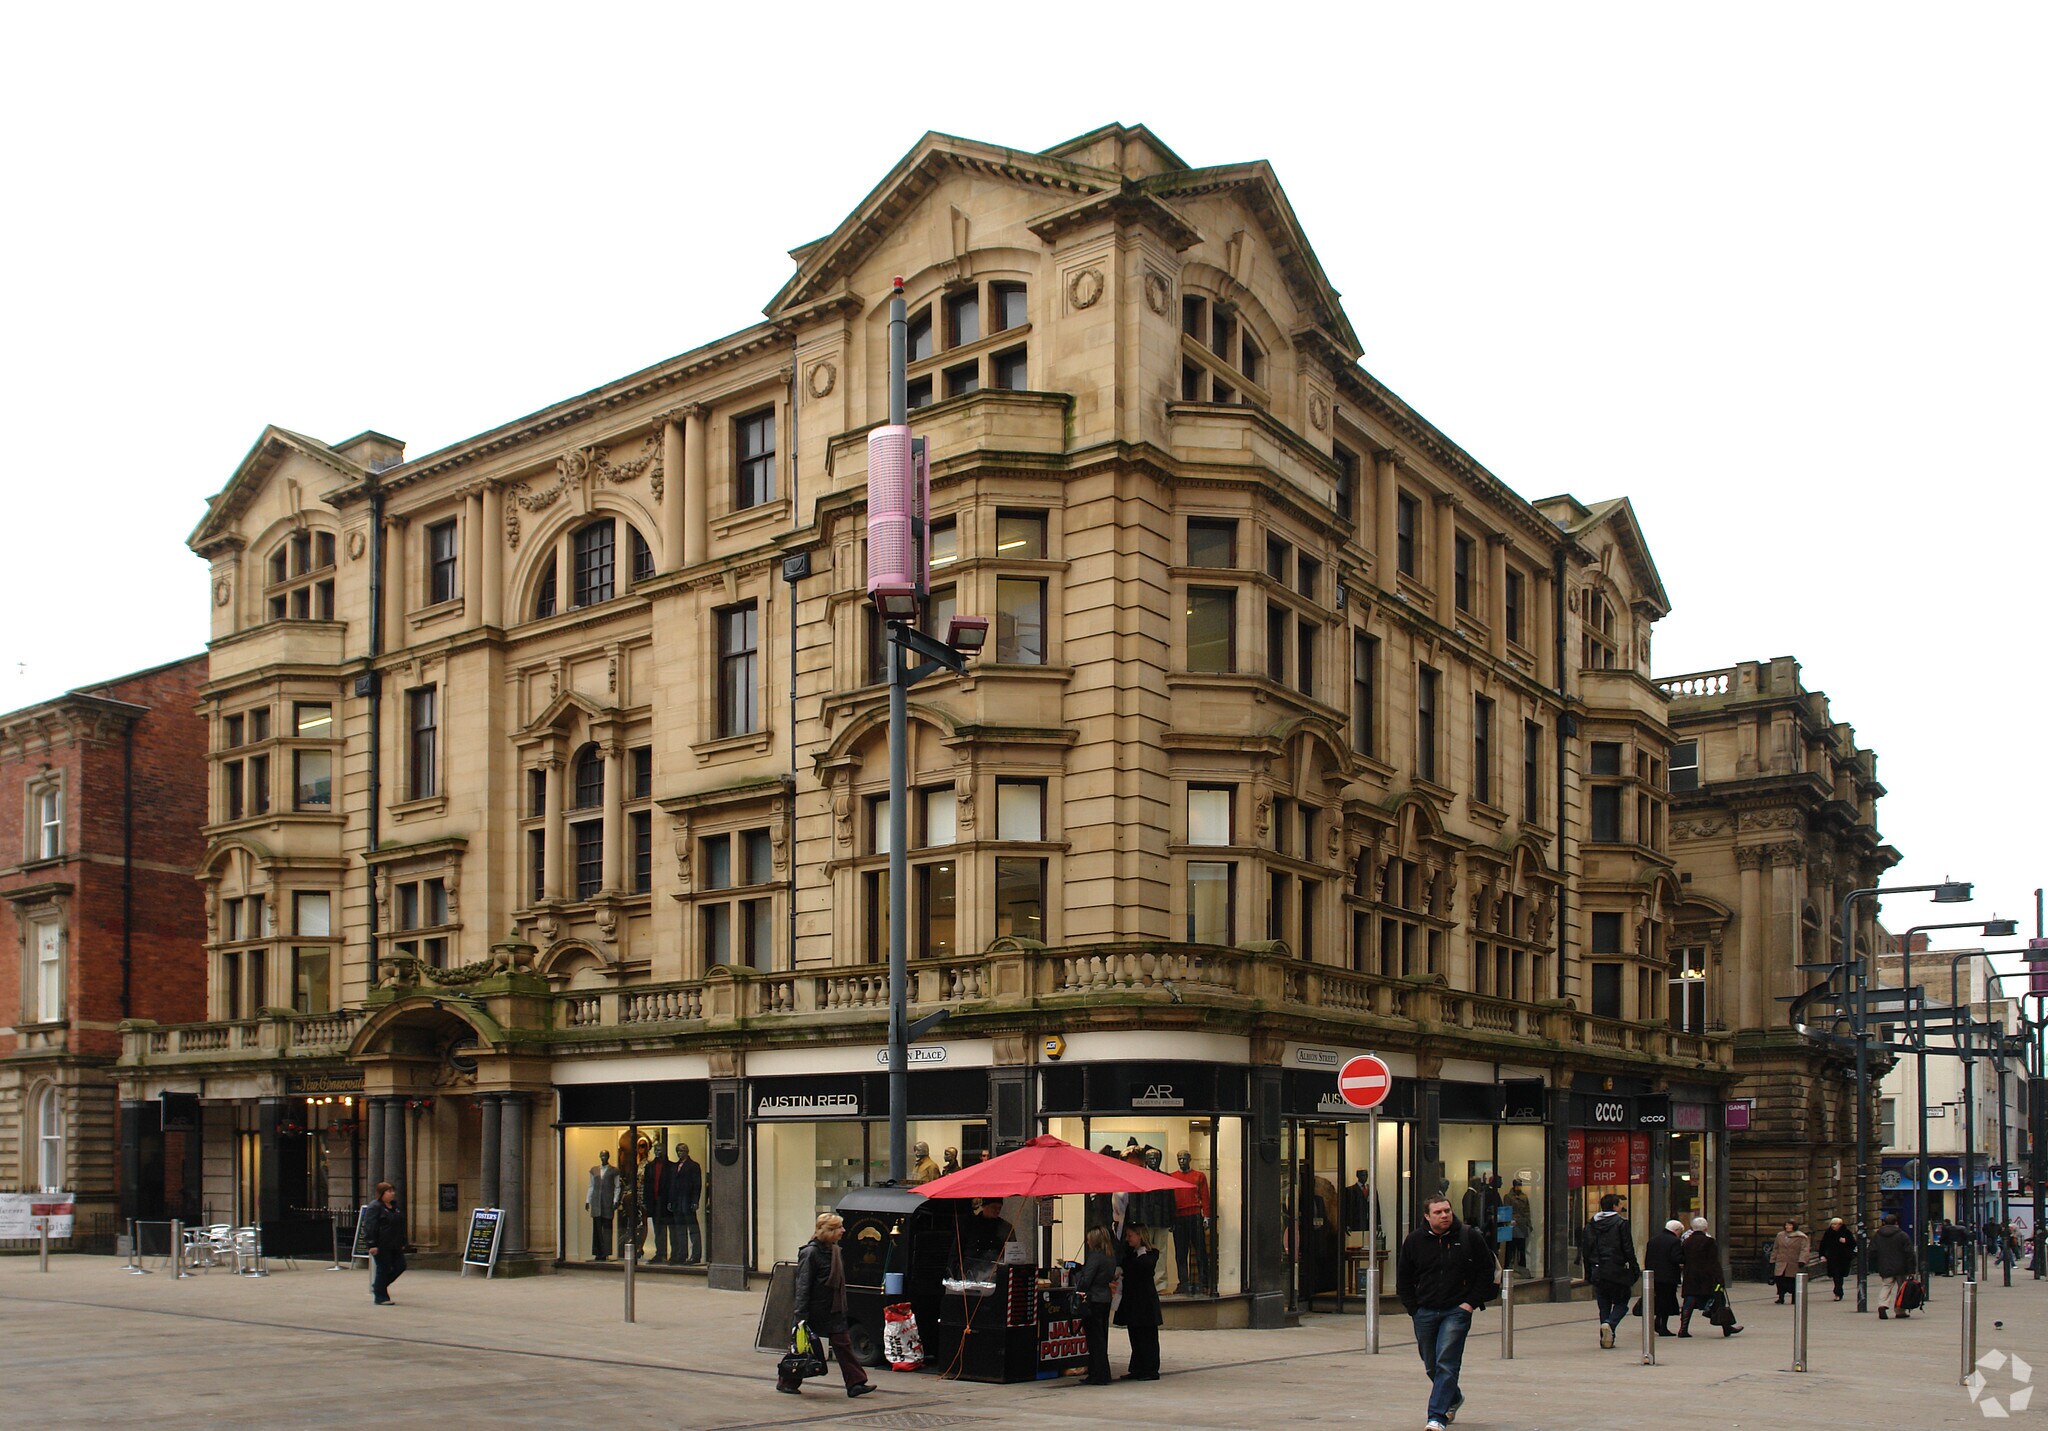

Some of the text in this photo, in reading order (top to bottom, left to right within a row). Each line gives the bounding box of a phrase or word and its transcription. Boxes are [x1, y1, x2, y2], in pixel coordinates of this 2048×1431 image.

[915, 1049, 942, 1060] PLACE
[1318, 1052, 1337, 1063] STREET
[1143, 1084, 1173, 1098] AR
[759, 1094, 858, 1107] AUSTIN REED
[1595, 1103, 1624, 1122] ecco
[1640, 1115, 1666, 1123] ecco
[1587, 1135, 1626, 1144] MINIMUM
[1594, 1159, 1616, 1168] OFF
[1593, 1172, 1617, 1181] RRP
